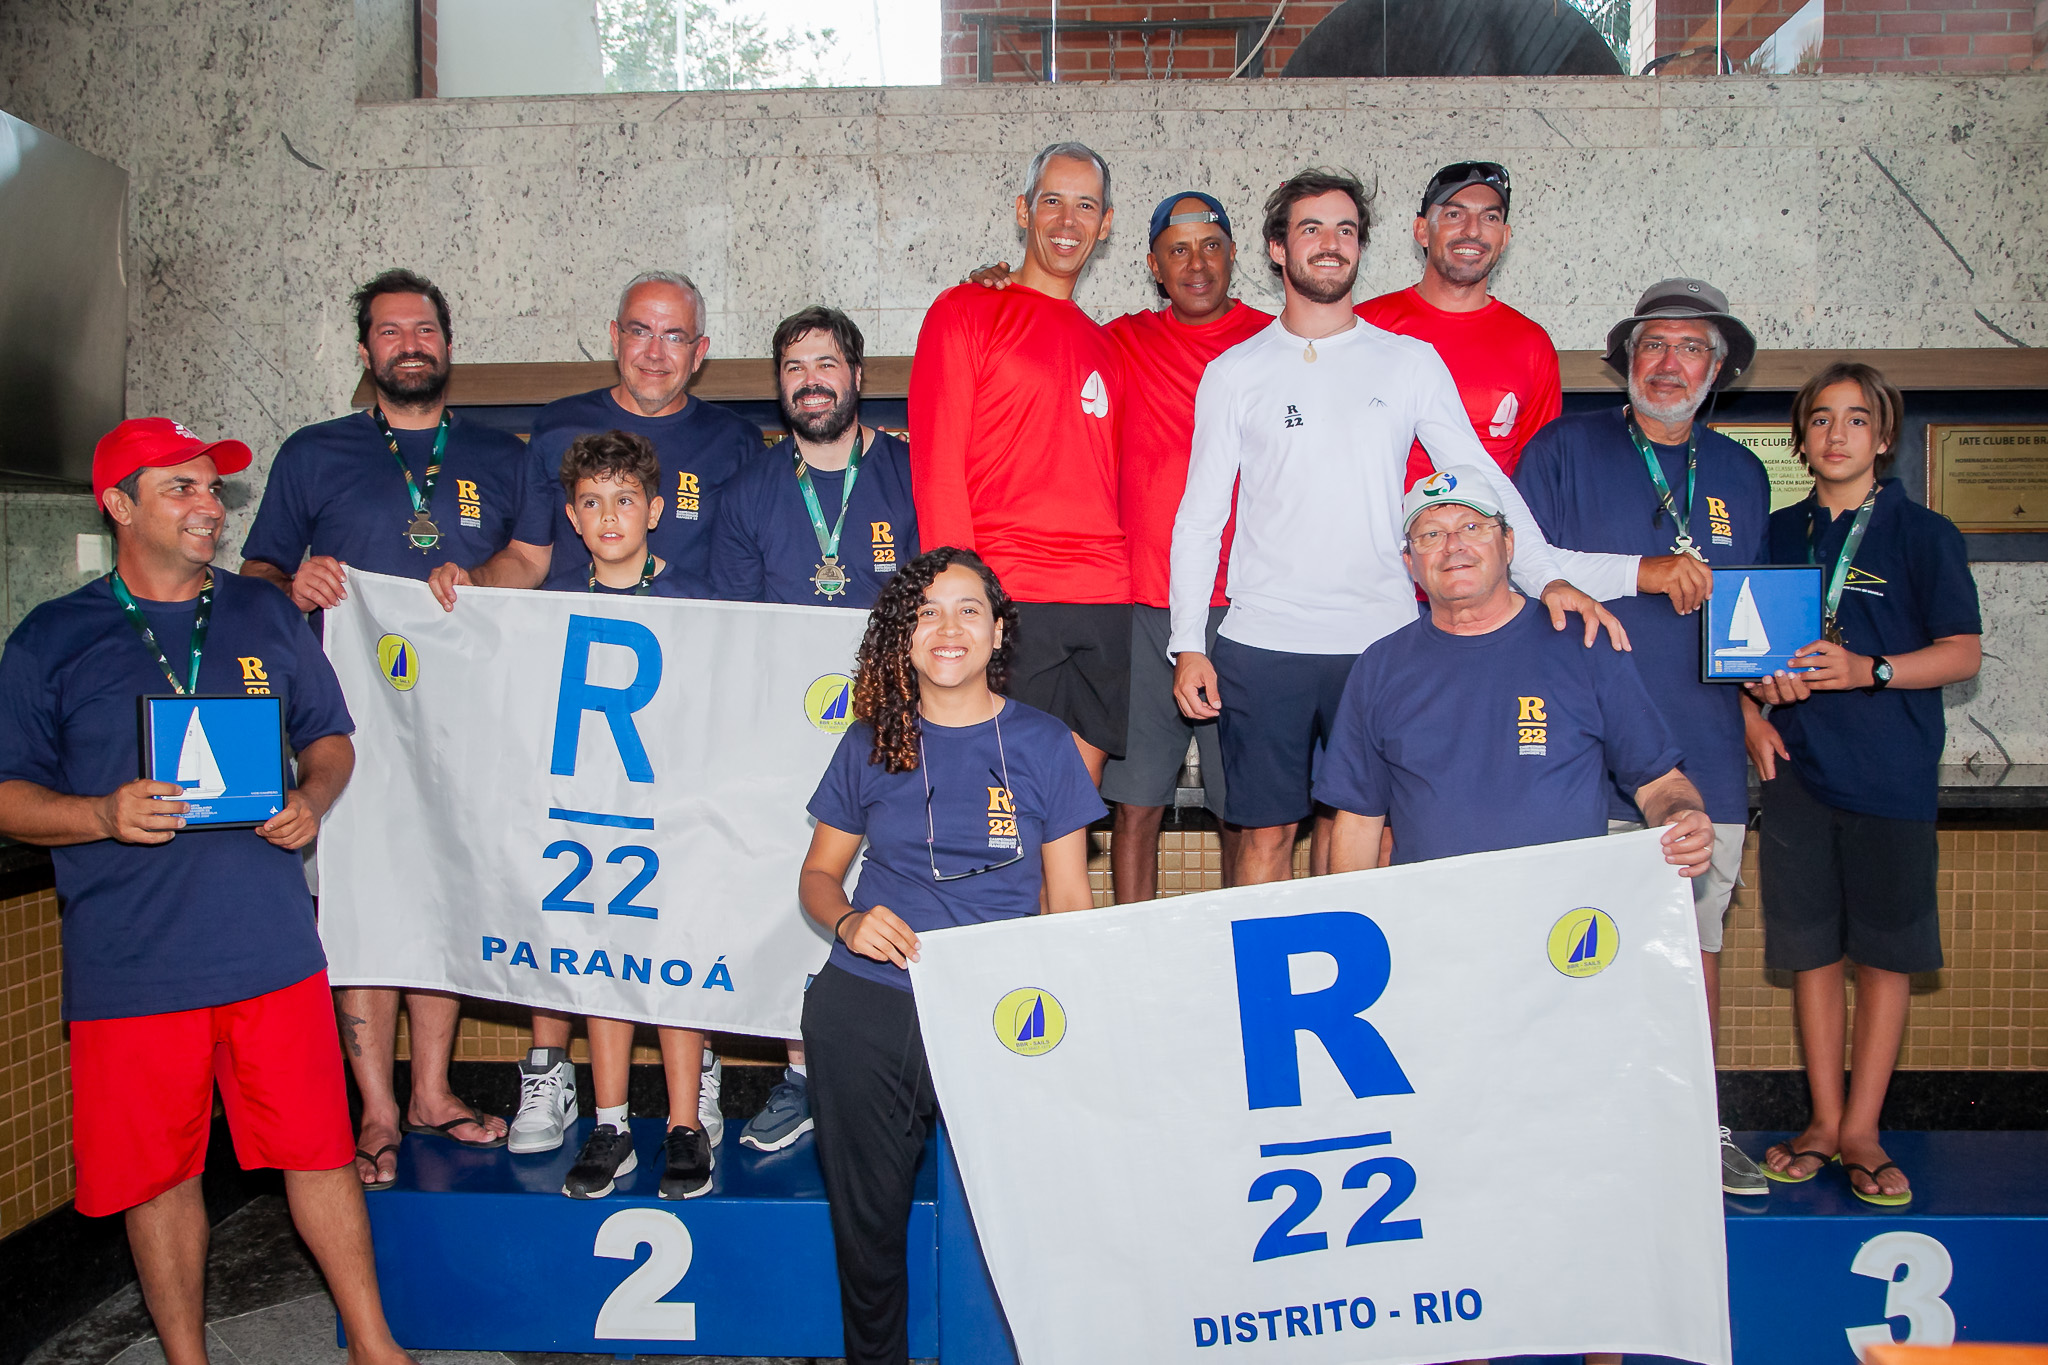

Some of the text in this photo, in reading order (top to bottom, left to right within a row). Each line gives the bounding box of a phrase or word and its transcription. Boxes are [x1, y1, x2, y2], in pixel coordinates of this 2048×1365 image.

[1287, 404, 1298, 414] R
[1284, 417, 1304, 428] 22
[1959, 437, 1981, 446] IATE
[1983, 436, 2015, 445] CLUBE
[2018, 436, 2031, 445] DE
[456, 479, 480, 500] R
[678, 471, 700, 493] R
[459, 504, 481, 519] 22
[677, 497, 700, 511] 22
[1705, 496, 1730, 519] R
[870, 521, 894, 543] R
[1710, 522, 1733, 537] 22
[873, 549, 896, 563] 22
[237, 656, 268, 680] R
[550, 613, 663, 784] R
[1517, 696, 1547, 721] R
[1518, 728, 1548, 744] 22
[987, 786, 1016, 813] R
[988, 819, 1017, 836] 22
[542, 839, 659, 920] 22
[482, 935, 735, 992] PARANOÁ
[1231, 911, 1416, 1111] R
[1247, 1156, 1424, 1263] 22
[593, 1208, 696, 1341] 2
[1845, 1230, 1956, 1364] 3
[1193, 1287, 1483, 1348] DISTRITO - RIO
